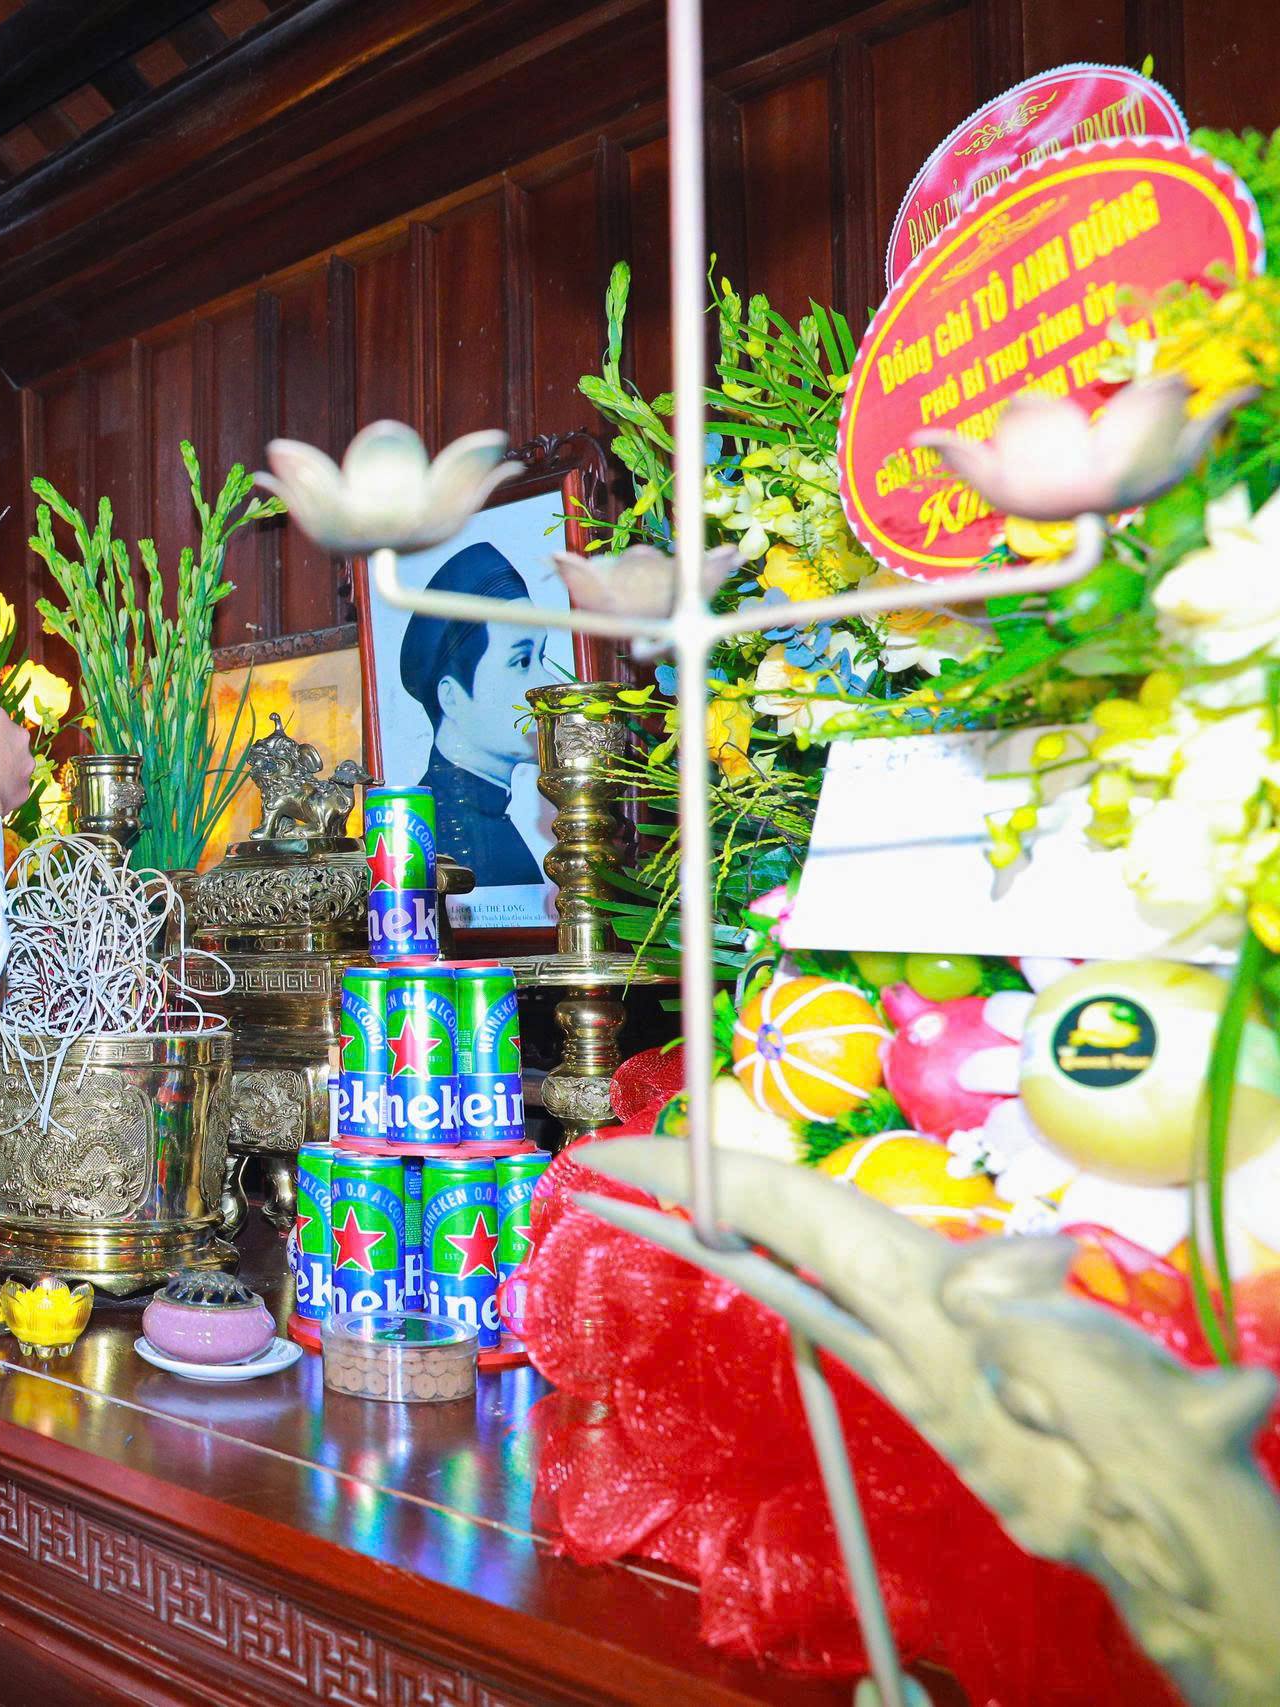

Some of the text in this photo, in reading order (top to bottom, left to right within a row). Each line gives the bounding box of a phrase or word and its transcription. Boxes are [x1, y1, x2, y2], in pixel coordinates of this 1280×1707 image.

[877, 339, 933, 395] Đồng
[934, 299, 973, 358] chí
[1012, 235, 1070, 310] ANH
[1068, 180, 1160, 270] DŨNG
[920, 374, 961, 425] PHÓ
[960, 356, 986, 401] BÍ
[985, 332, 1029, 385] THƯ
[423, 1188, 468, 1248] HEINEKEN
